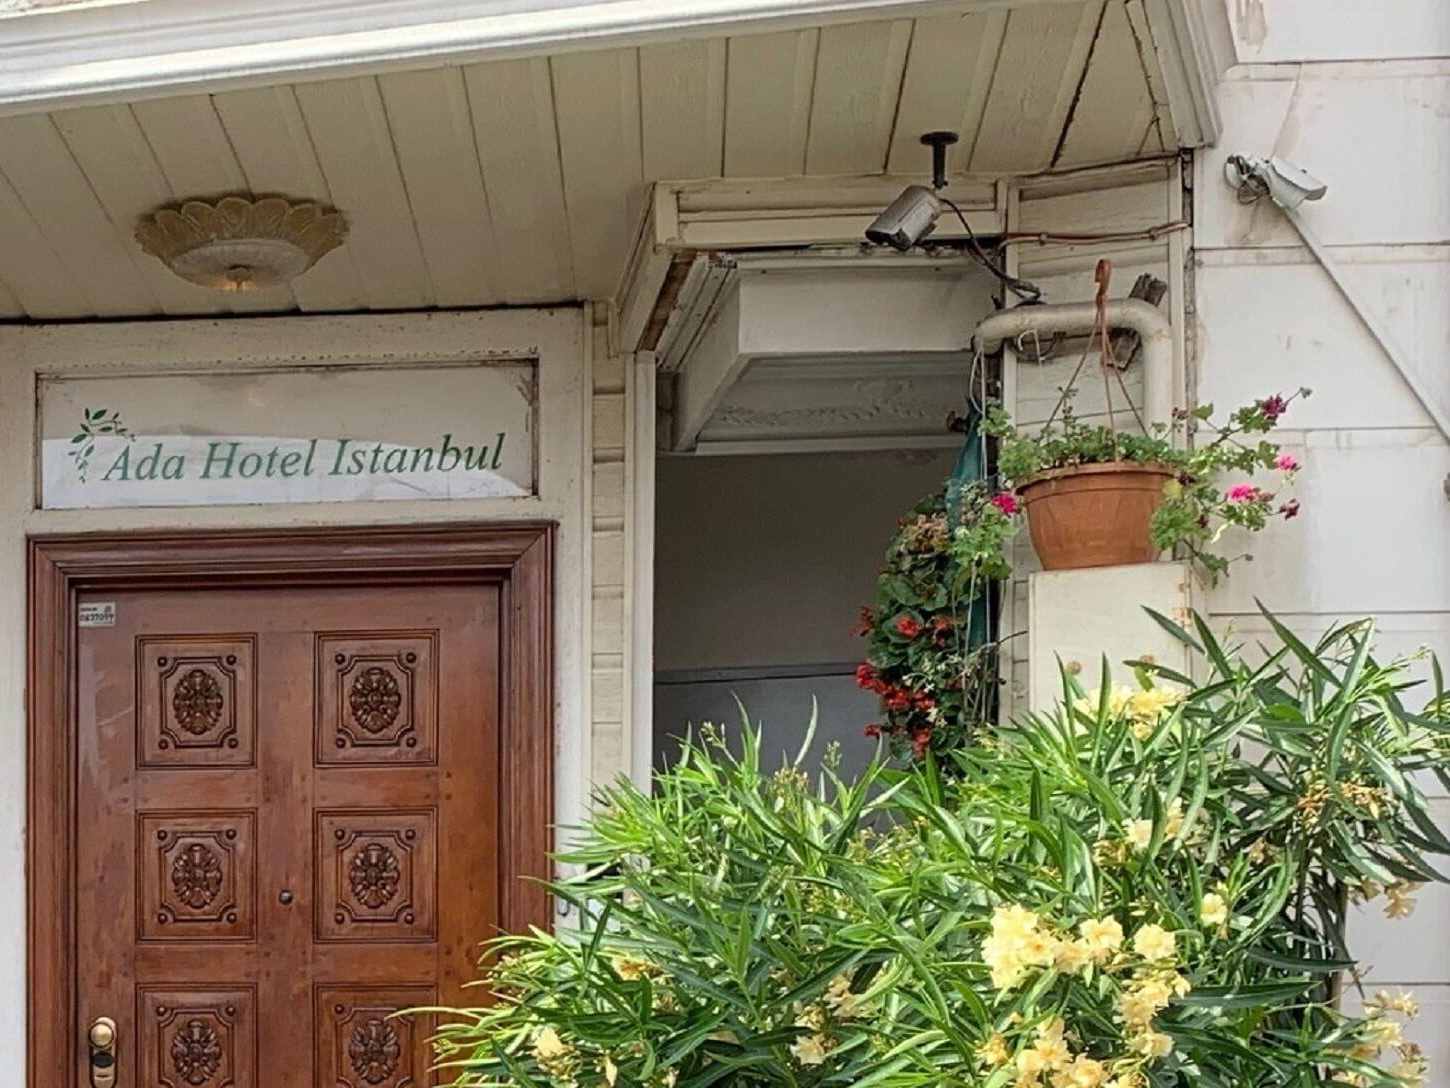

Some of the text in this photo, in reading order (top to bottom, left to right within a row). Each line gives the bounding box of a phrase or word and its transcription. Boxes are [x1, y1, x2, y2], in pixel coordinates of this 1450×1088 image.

[101, 432, 506, 482] Ada Hotel Istanbul
